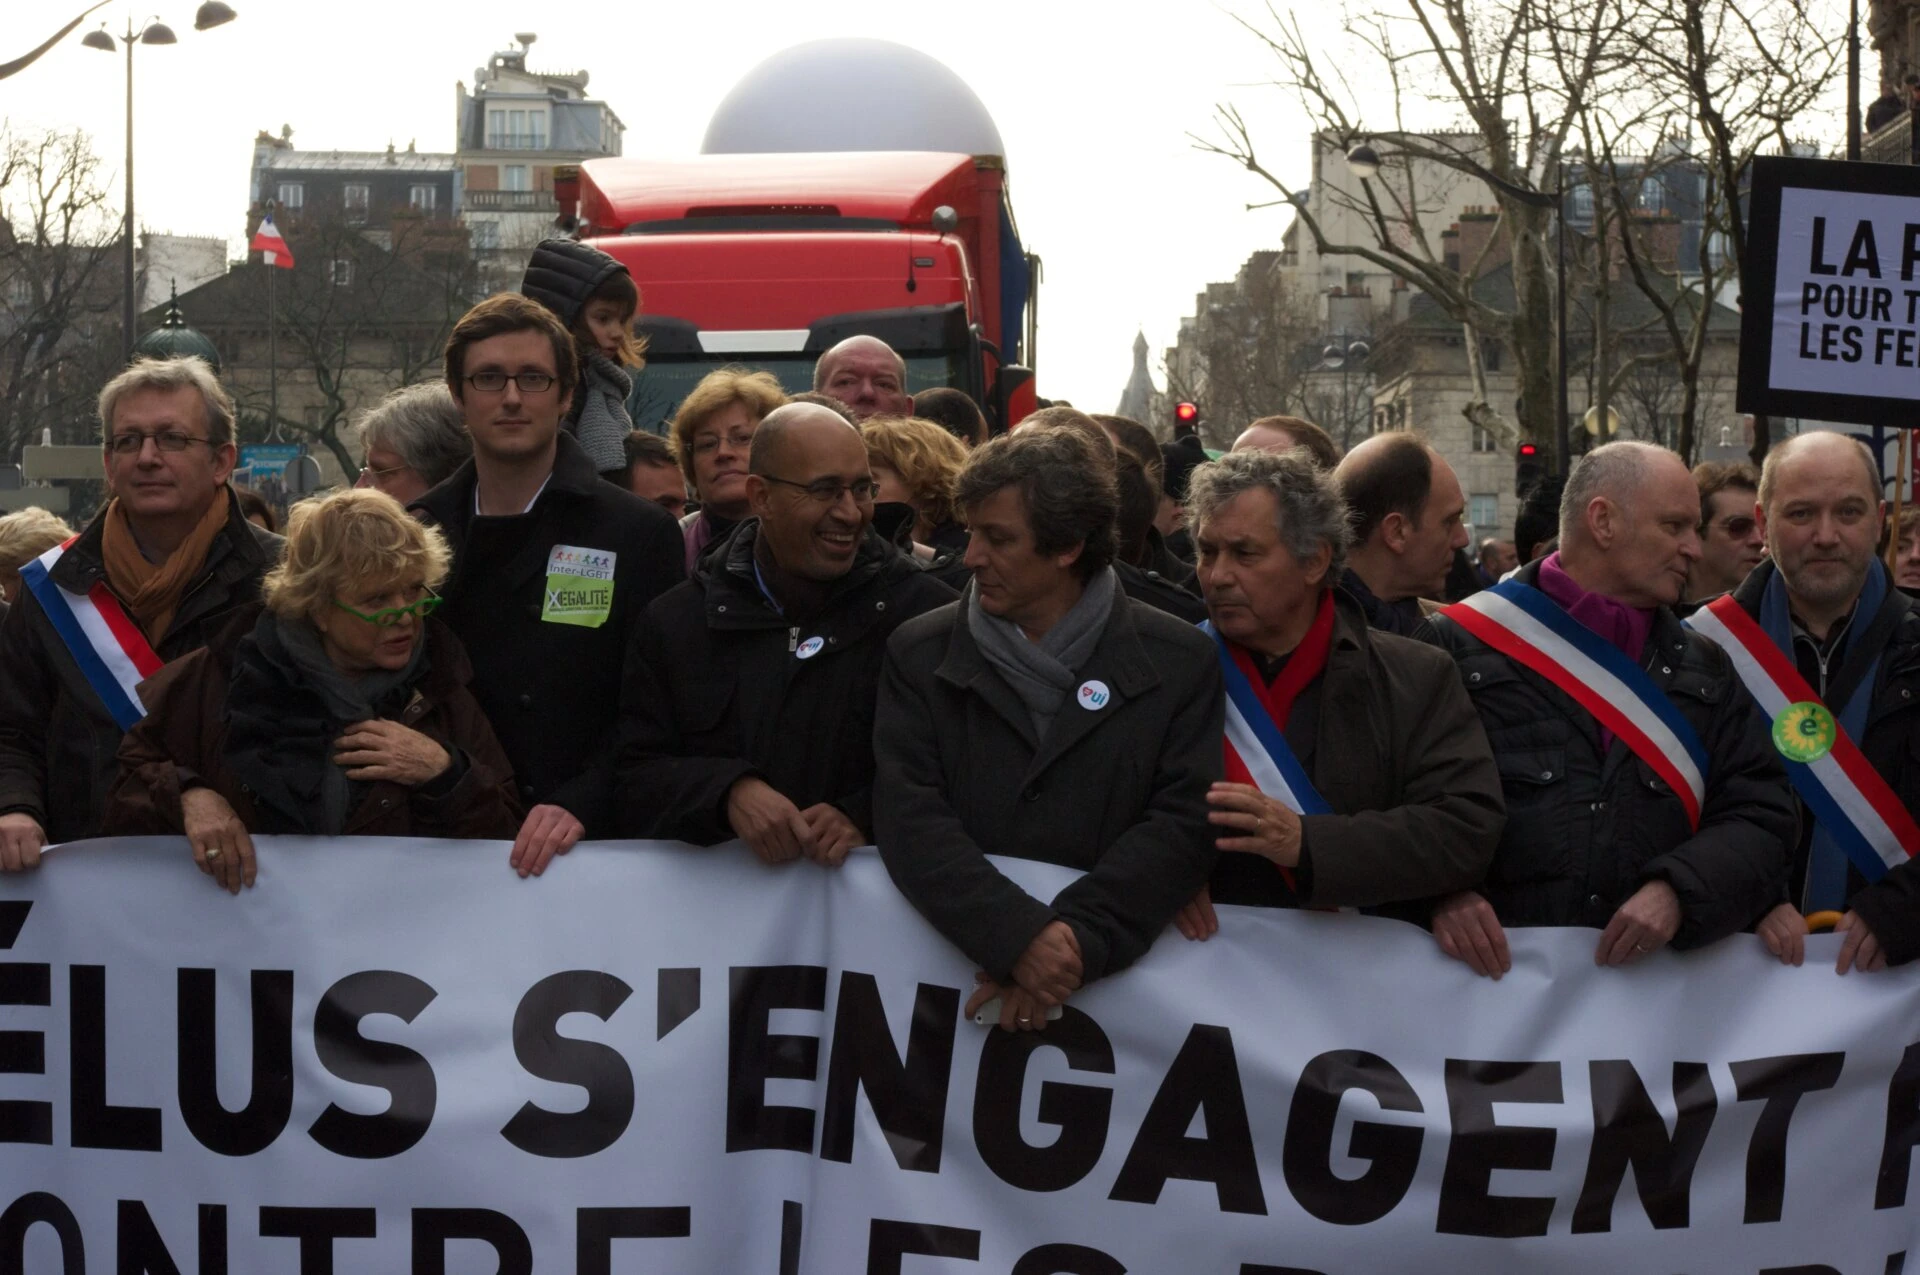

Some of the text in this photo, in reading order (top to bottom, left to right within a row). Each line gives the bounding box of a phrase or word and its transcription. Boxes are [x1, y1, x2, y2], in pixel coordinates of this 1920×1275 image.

[1810, 216, 1882, 279] LA
[1801, 281, 1892, 322] POUR
[1799, 323, 1920, 368] LES FE
[549, 564, 610, 579] Inter-LGBT
[0, 900, 439, 1160] ÉLUS
[500, 965, 1846, 1239] S'ENGAGENT
